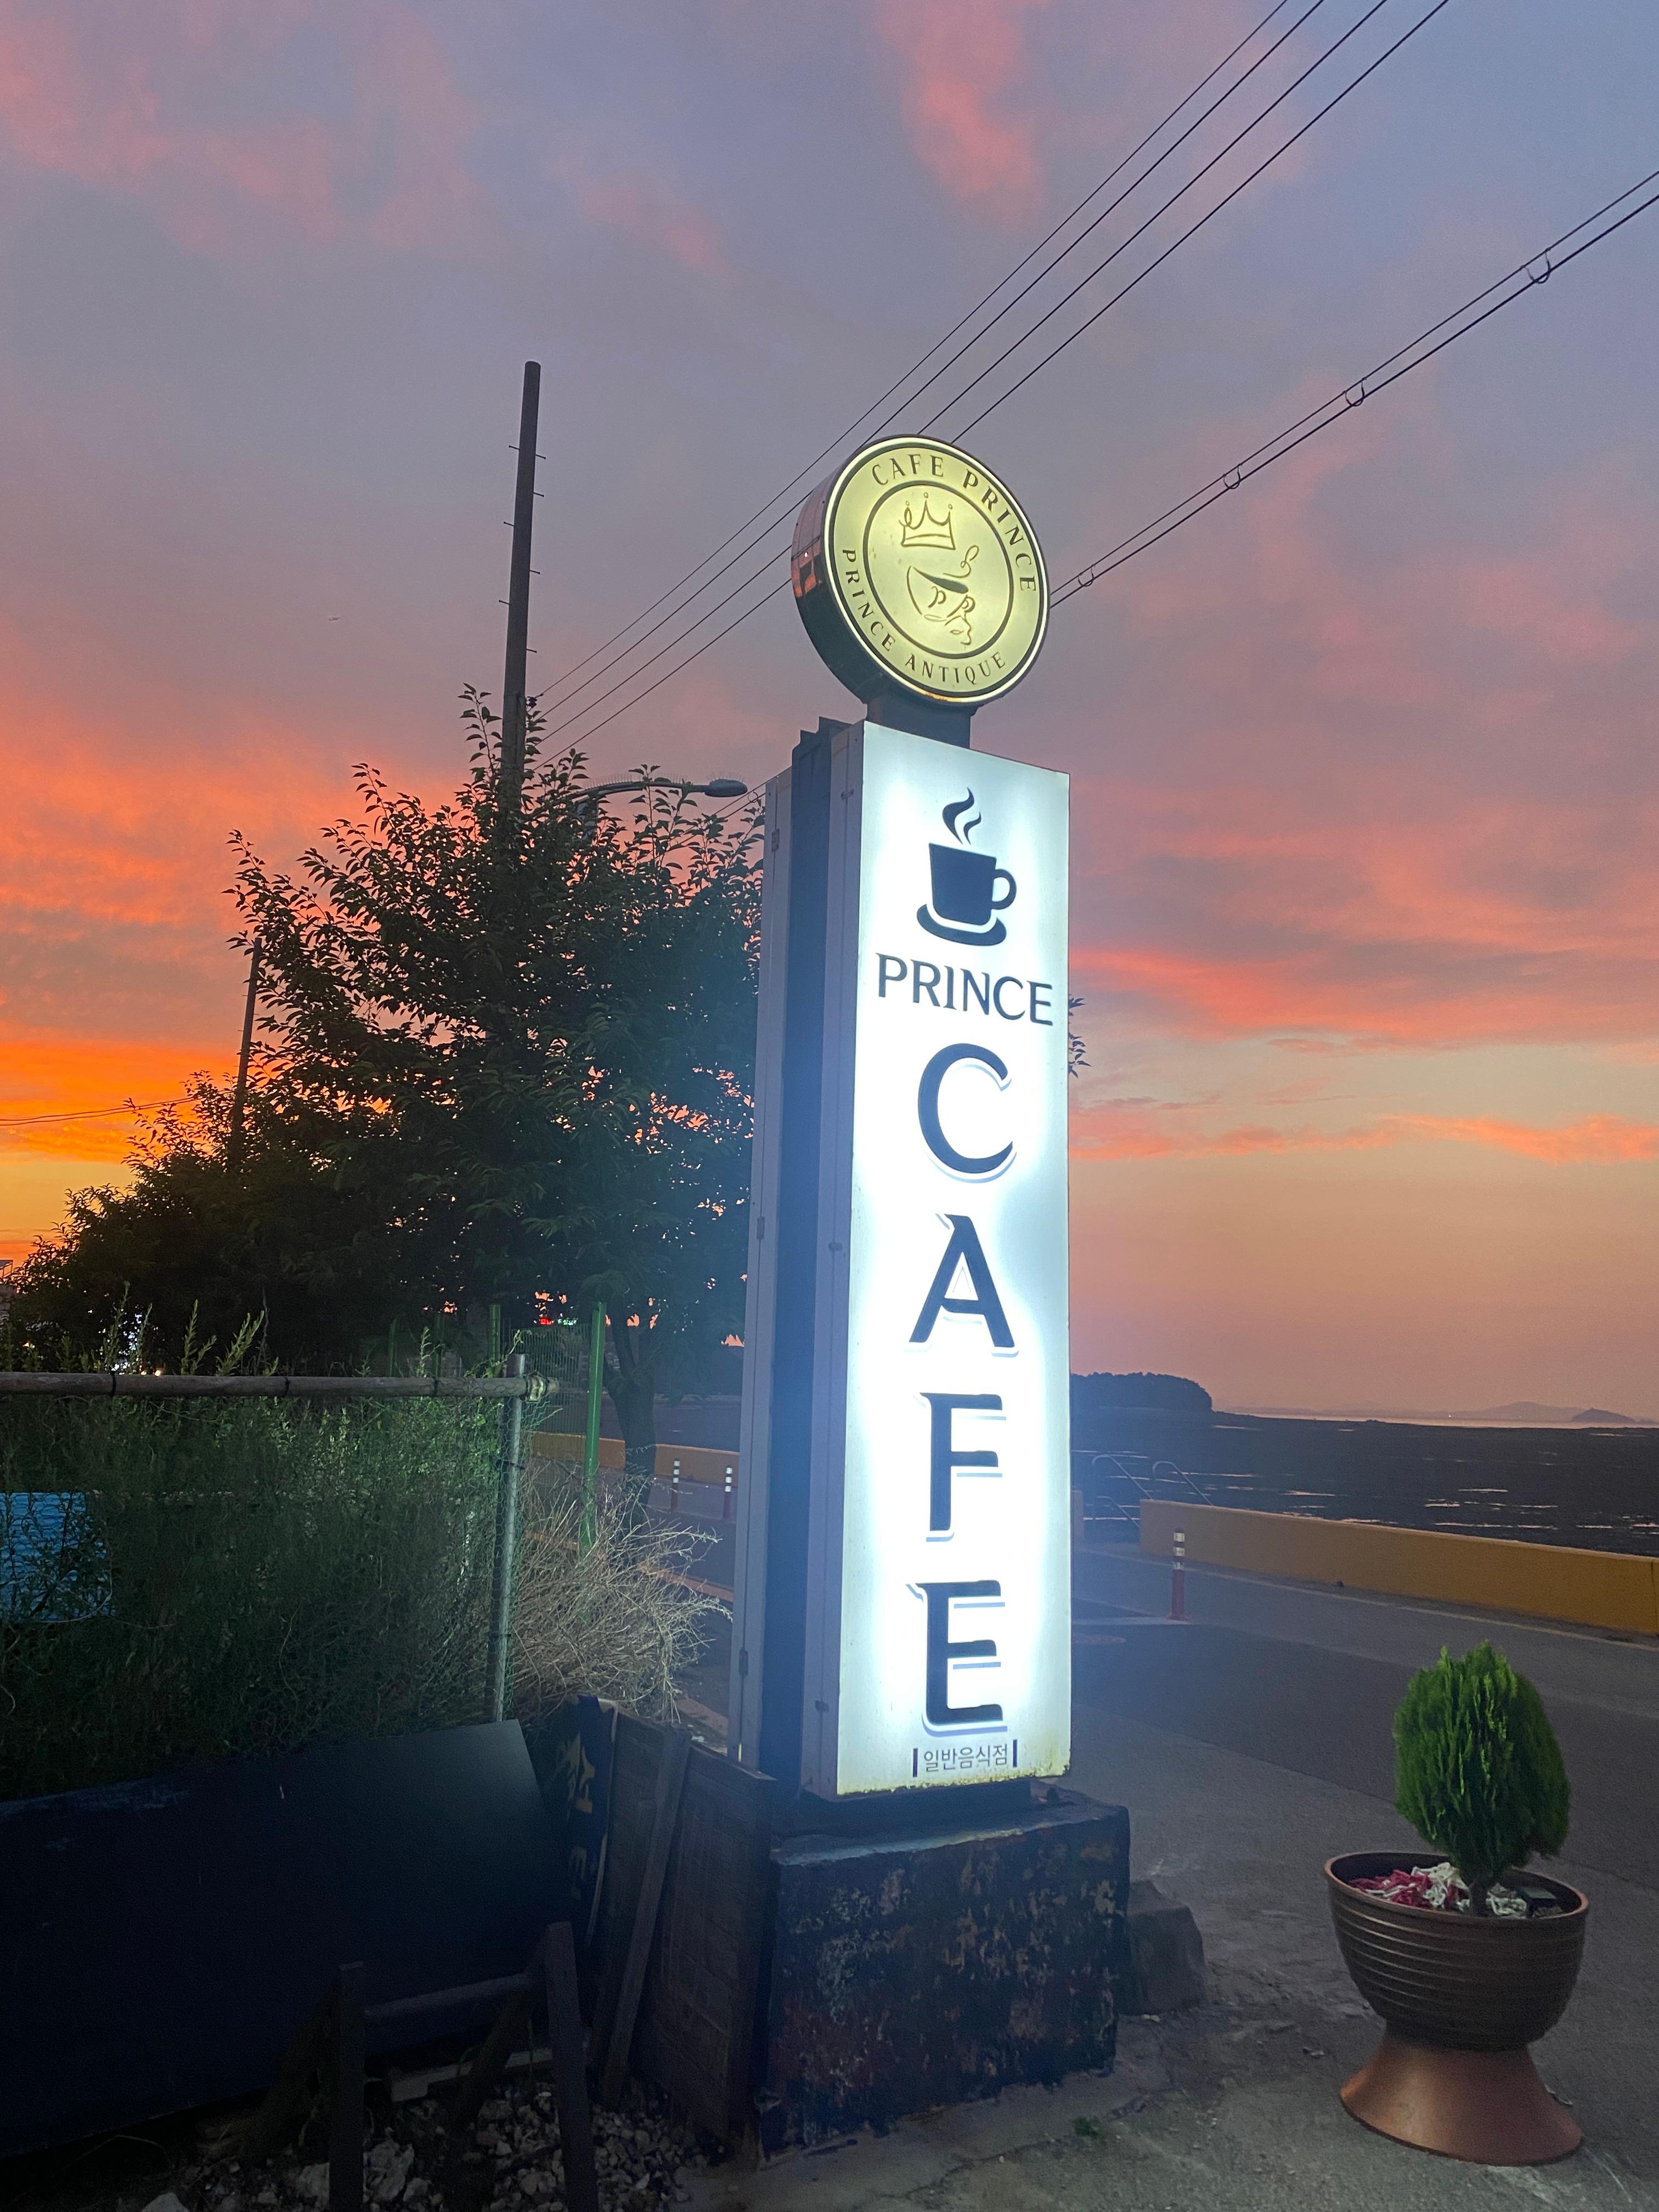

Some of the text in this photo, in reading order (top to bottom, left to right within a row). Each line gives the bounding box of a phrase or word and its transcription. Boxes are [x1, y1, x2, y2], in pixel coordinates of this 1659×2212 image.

[872, 454, 1037, 592] CAFE PRINCE
[842, 549, 1006, 685] PRINCE ANTIQUE
[875, 952, 1053, 1026] PRINCE
[907, 1042, 1016, 1727] CAFE
[923, 1743, 1008, 1773] 일반음식점
